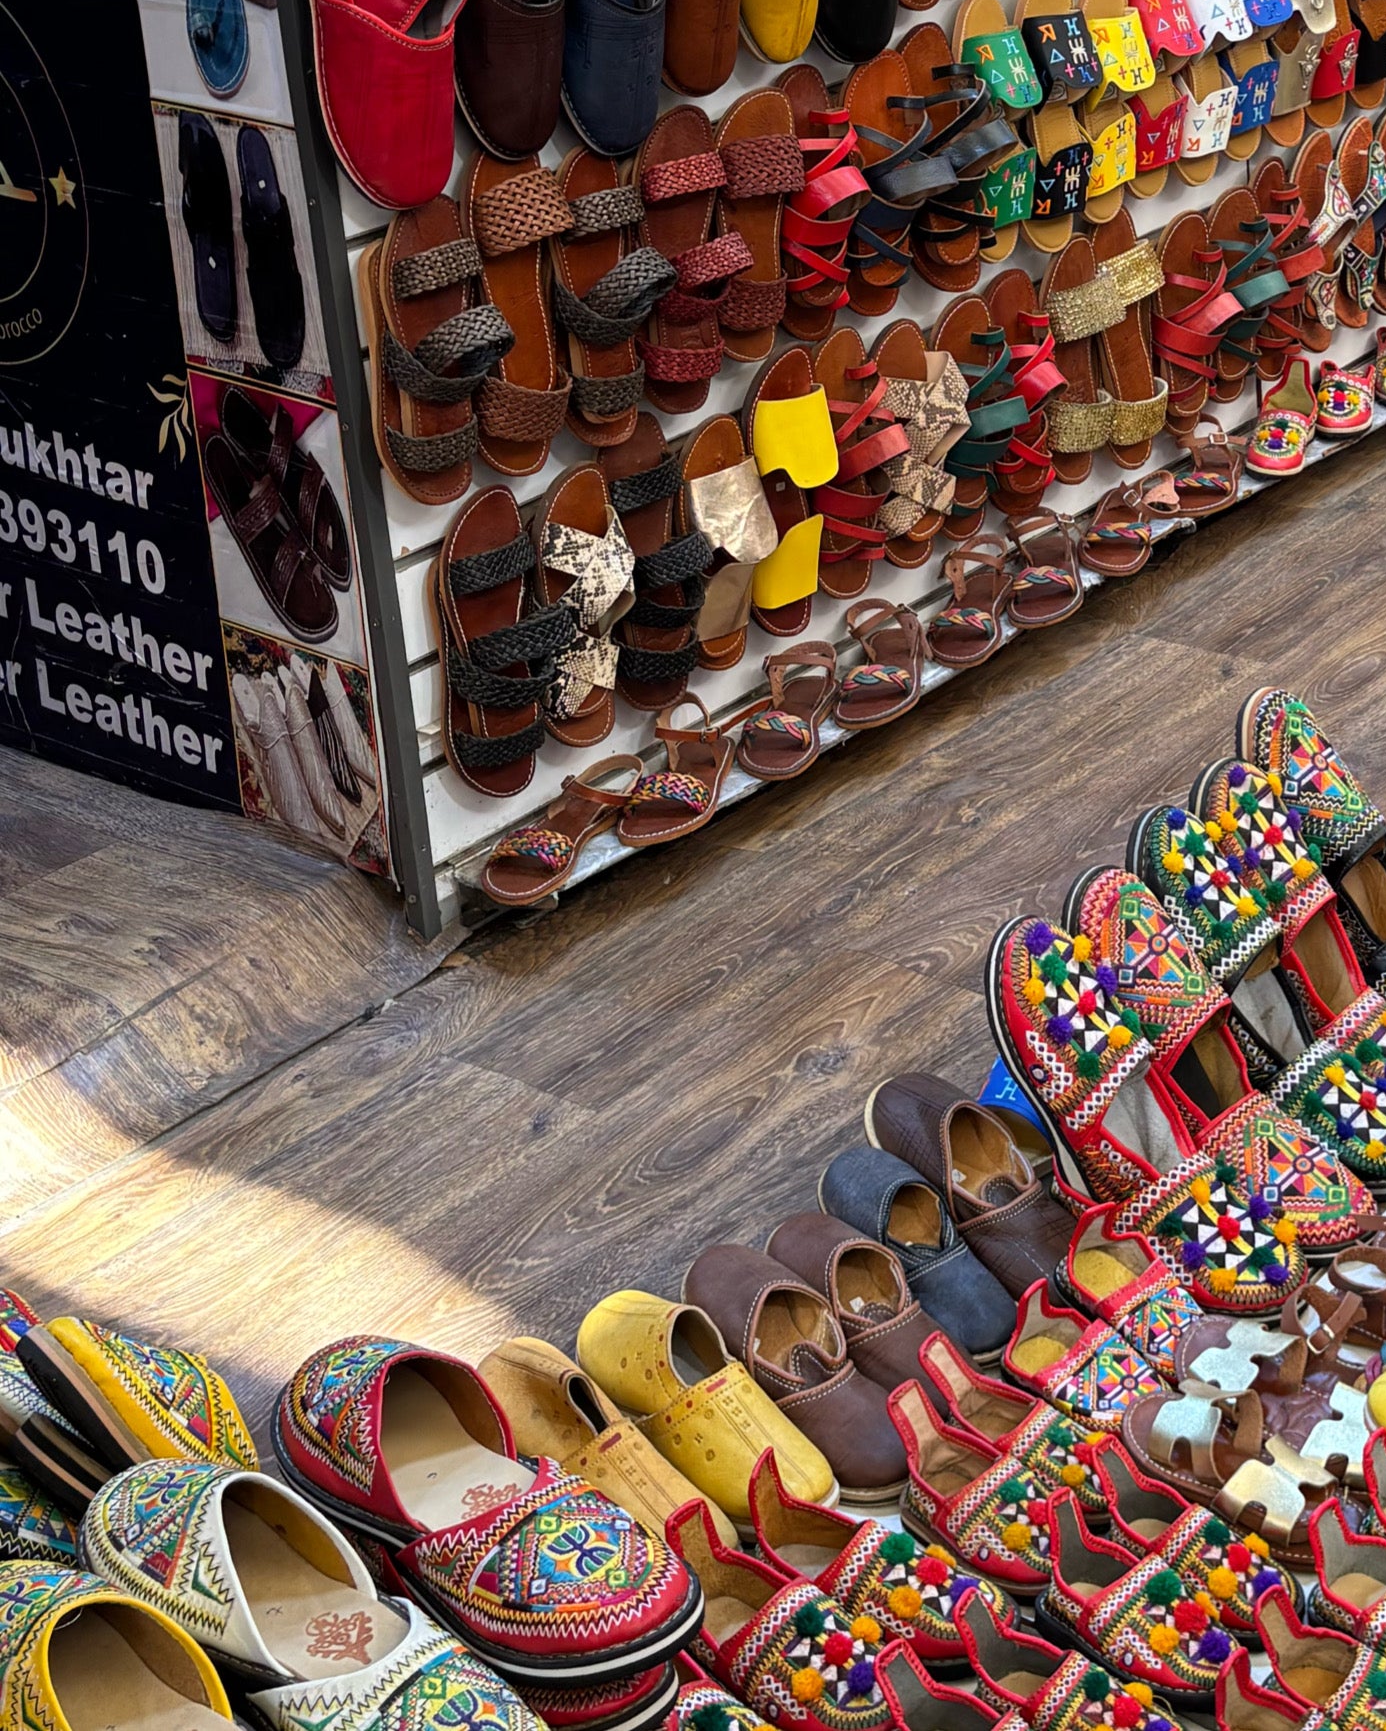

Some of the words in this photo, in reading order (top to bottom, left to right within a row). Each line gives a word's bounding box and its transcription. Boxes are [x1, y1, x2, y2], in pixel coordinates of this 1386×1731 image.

[0, 422, 154, 510] ukhtar
[0, 489, 166, 595] 393110
[25, 577, 213, 691] Leather
[0, 659, 21, 697] r
[35, 658, 223, 774] Leather
